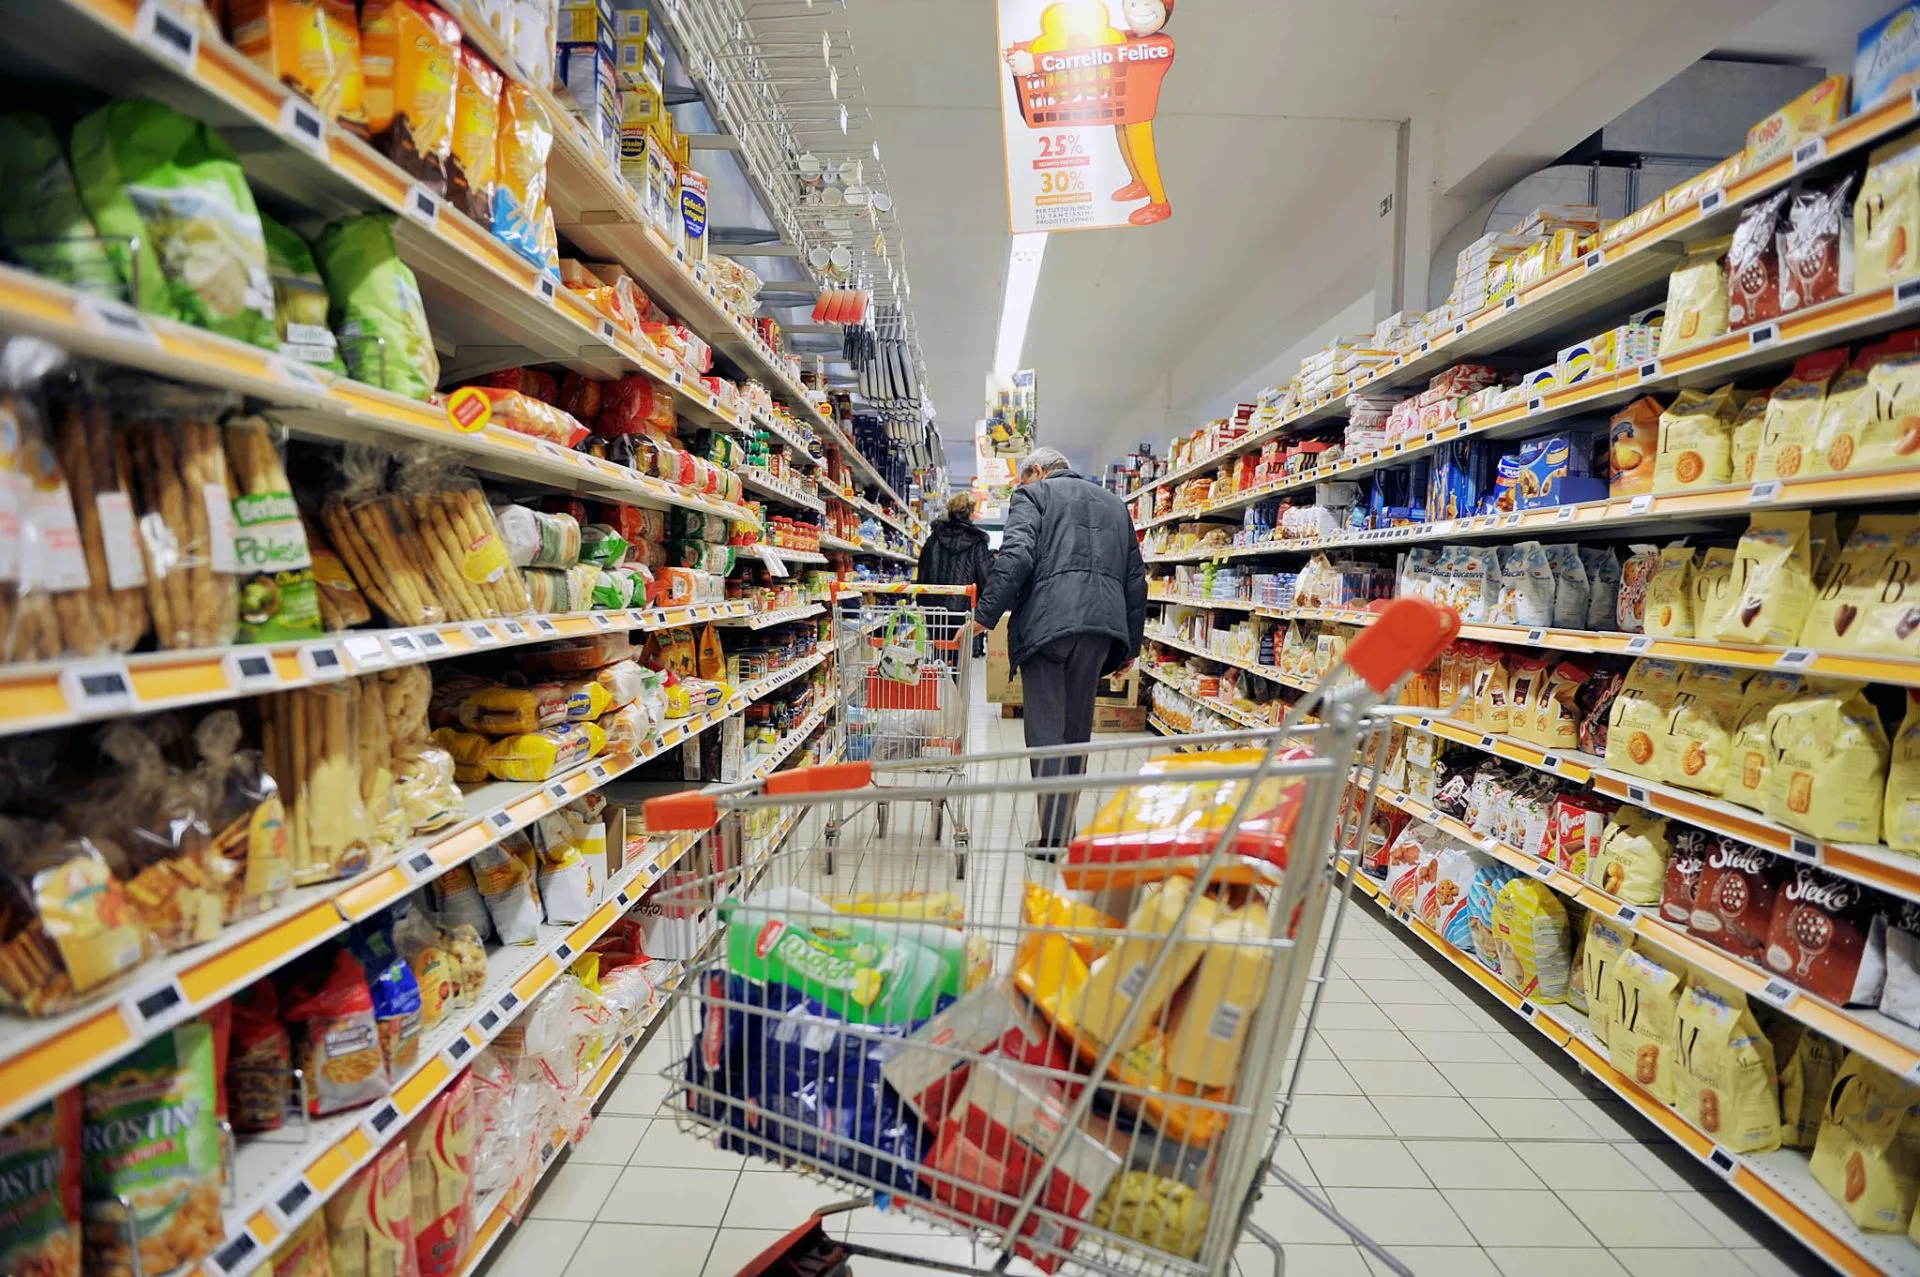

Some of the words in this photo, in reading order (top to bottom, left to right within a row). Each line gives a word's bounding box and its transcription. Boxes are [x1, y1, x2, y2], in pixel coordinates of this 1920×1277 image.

[1041, 49, 1113, 72] Carrello
[1117, 44, 1169, 63] Felice
[1038, 134, 1083, 157] 25%
[1040, 170, 1085, 193] 30%
[1453, 570, 1484, 579] Bucaneve
[1709, 838, 1765, 874] Stelle
[1785, 869, 1849, 911] Stelle
